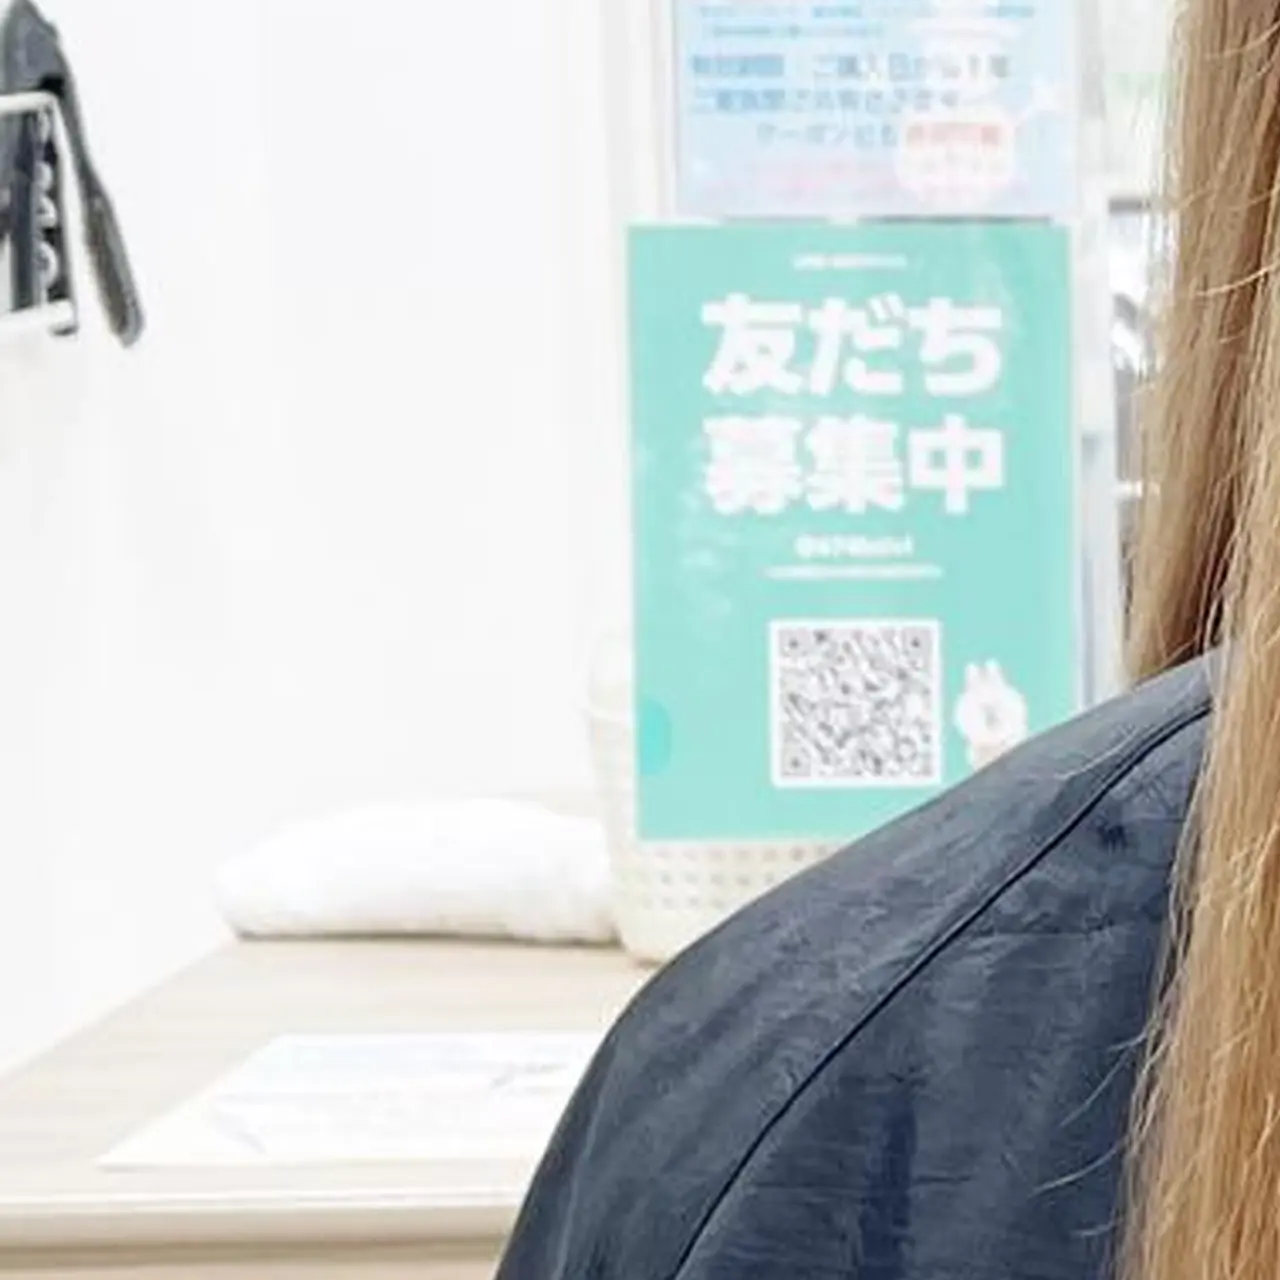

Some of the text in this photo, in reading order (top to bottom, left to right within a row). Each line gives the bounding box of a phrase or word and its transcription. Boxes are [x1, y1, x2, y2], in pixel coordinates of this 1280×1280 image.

[700, 294, 1004, 398] 友だち
[703, 413, 1006, 515] 募集中
